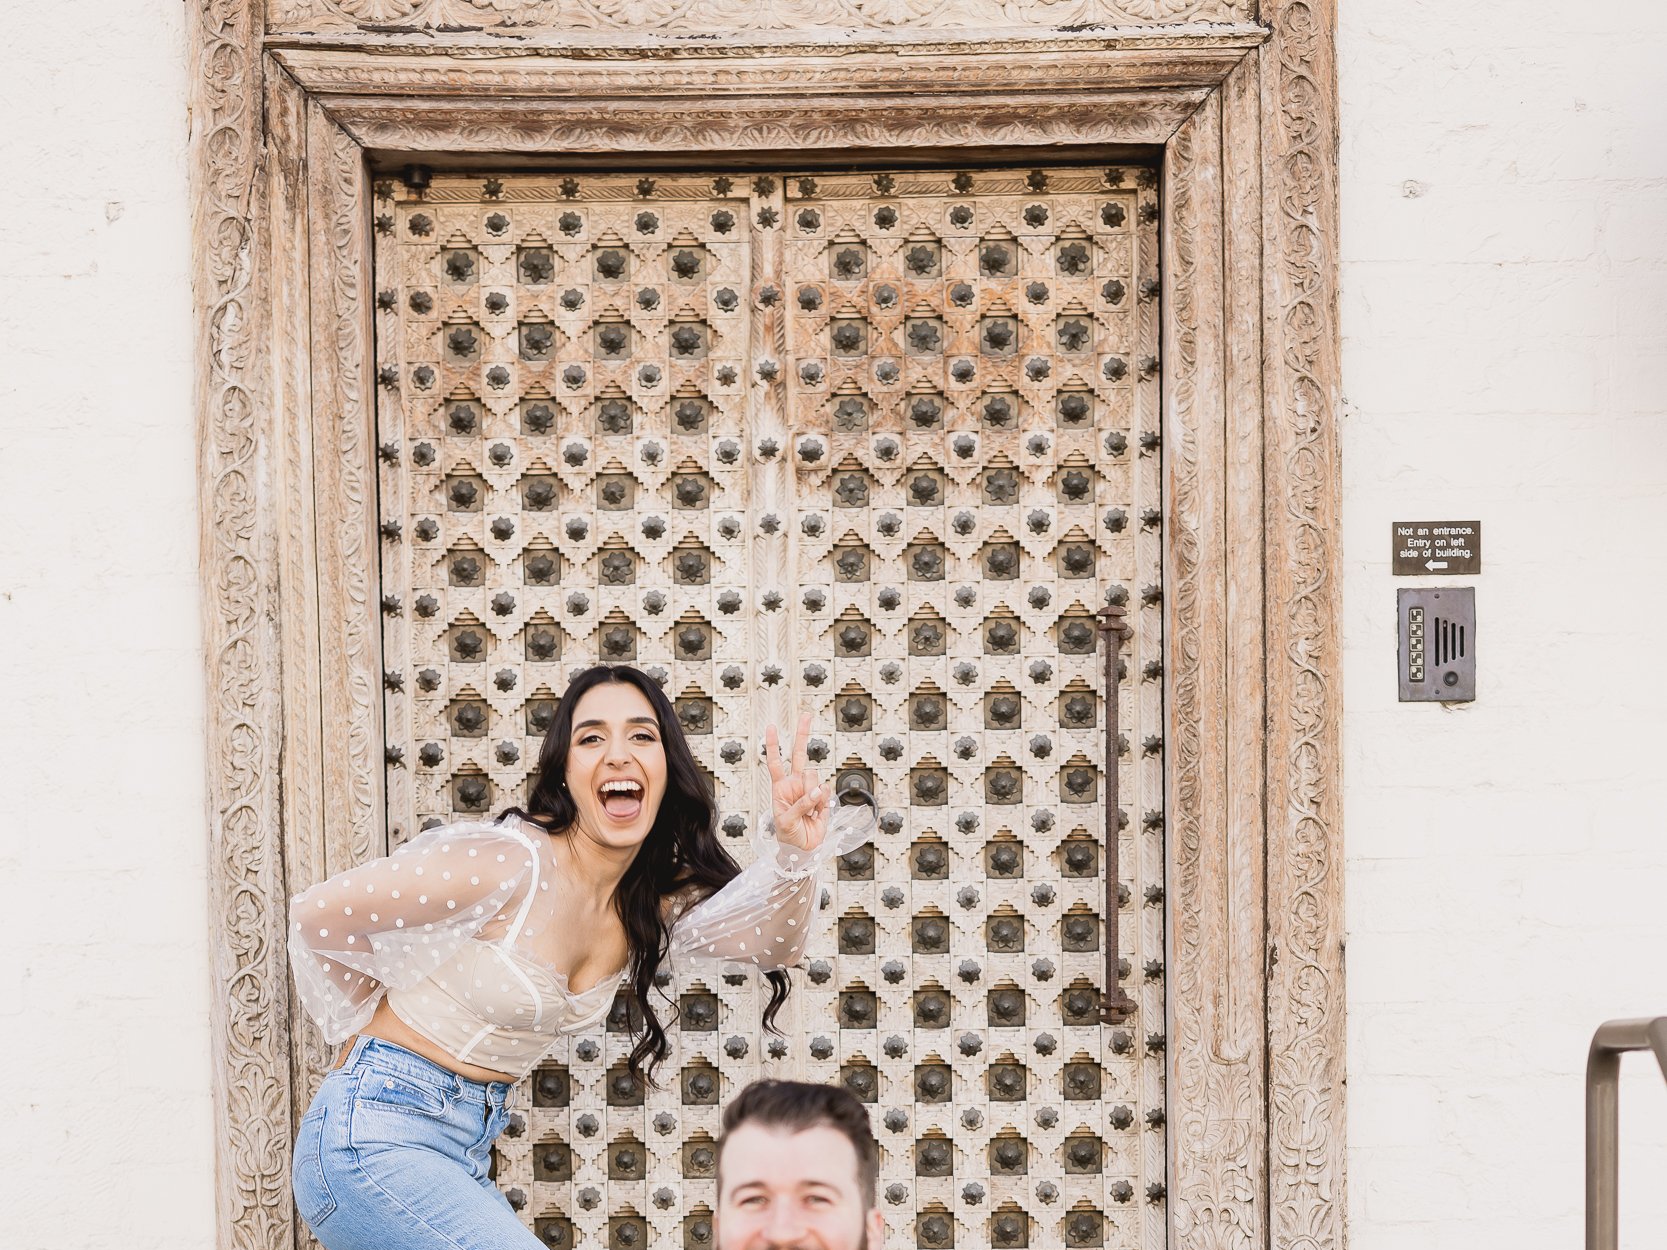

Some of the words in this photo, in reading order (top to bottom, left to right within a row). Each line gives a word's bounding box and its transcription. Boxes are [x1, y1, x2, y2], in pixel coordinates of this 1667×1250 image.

[1397, 527, 1413, 536] Not
[1417, 528, 1428, 536] an
[1432, 527, 1475, 535] entrance.
[1407, 538, 1431, 548] Entry
[1434, 539, 1447, 547] on
[1450, 537, 1465, 547] left
[1399, 549, 1419, 558] side
[1422, 548, 1432, 558] of
[1435, 548, 1473, 559] building.
